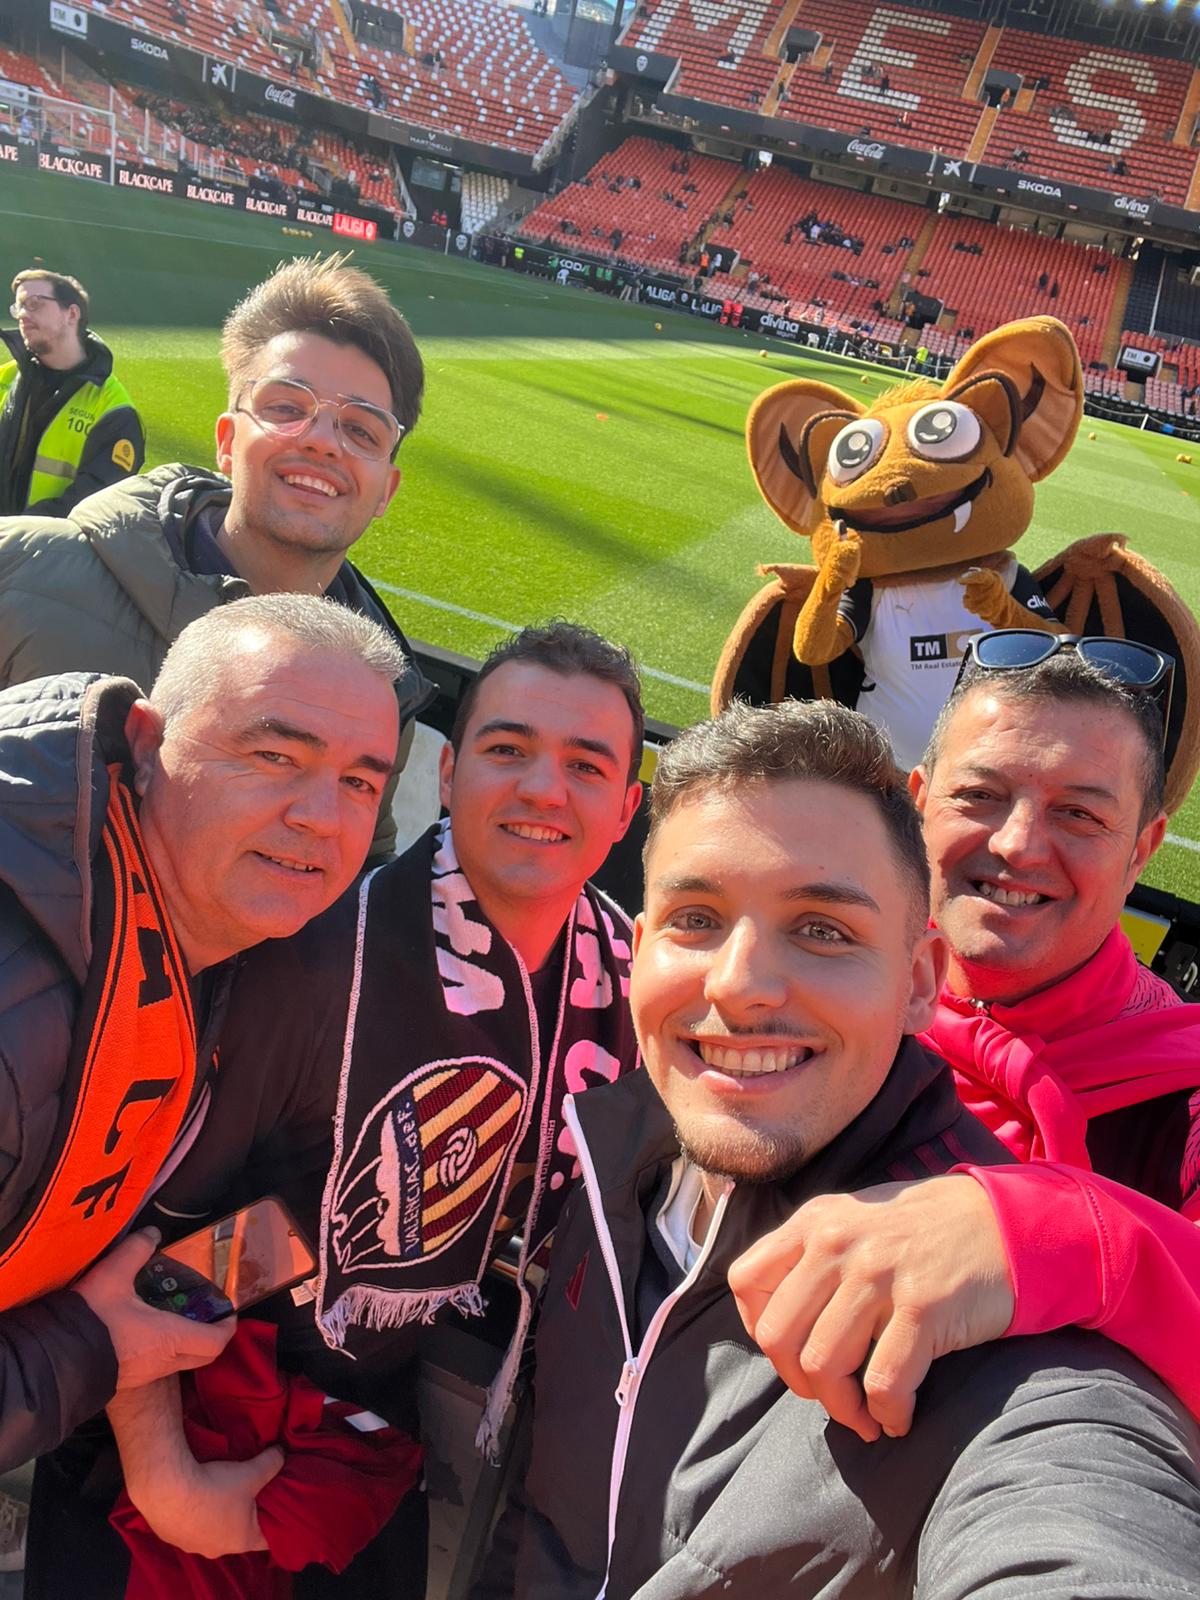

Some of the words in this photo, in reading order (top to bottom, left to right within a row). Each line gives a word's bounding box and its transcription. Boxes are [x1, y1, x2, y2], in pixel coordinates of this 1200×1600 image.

[39, 152, 104, 179] BLACKCAPE
[119, 170, 174, 193] BLACKCAPE
[187, 184, 235, 206] BLACKCAPE
[246, 197, 288, 217] BLACKCAPE
[1114, 197, 1150, 214] divina
[297, 208, 334, 226] BLACKCAPE
[335, 214, 364, 237] LALIGA
[760, 313, 799, 333] divina
[914, 640, 941, 657] TM
[911, 662, 923, 671] TM
[924, 662, 939, 670] Real
[403, 1165, 421, 1253] VALENCIA
